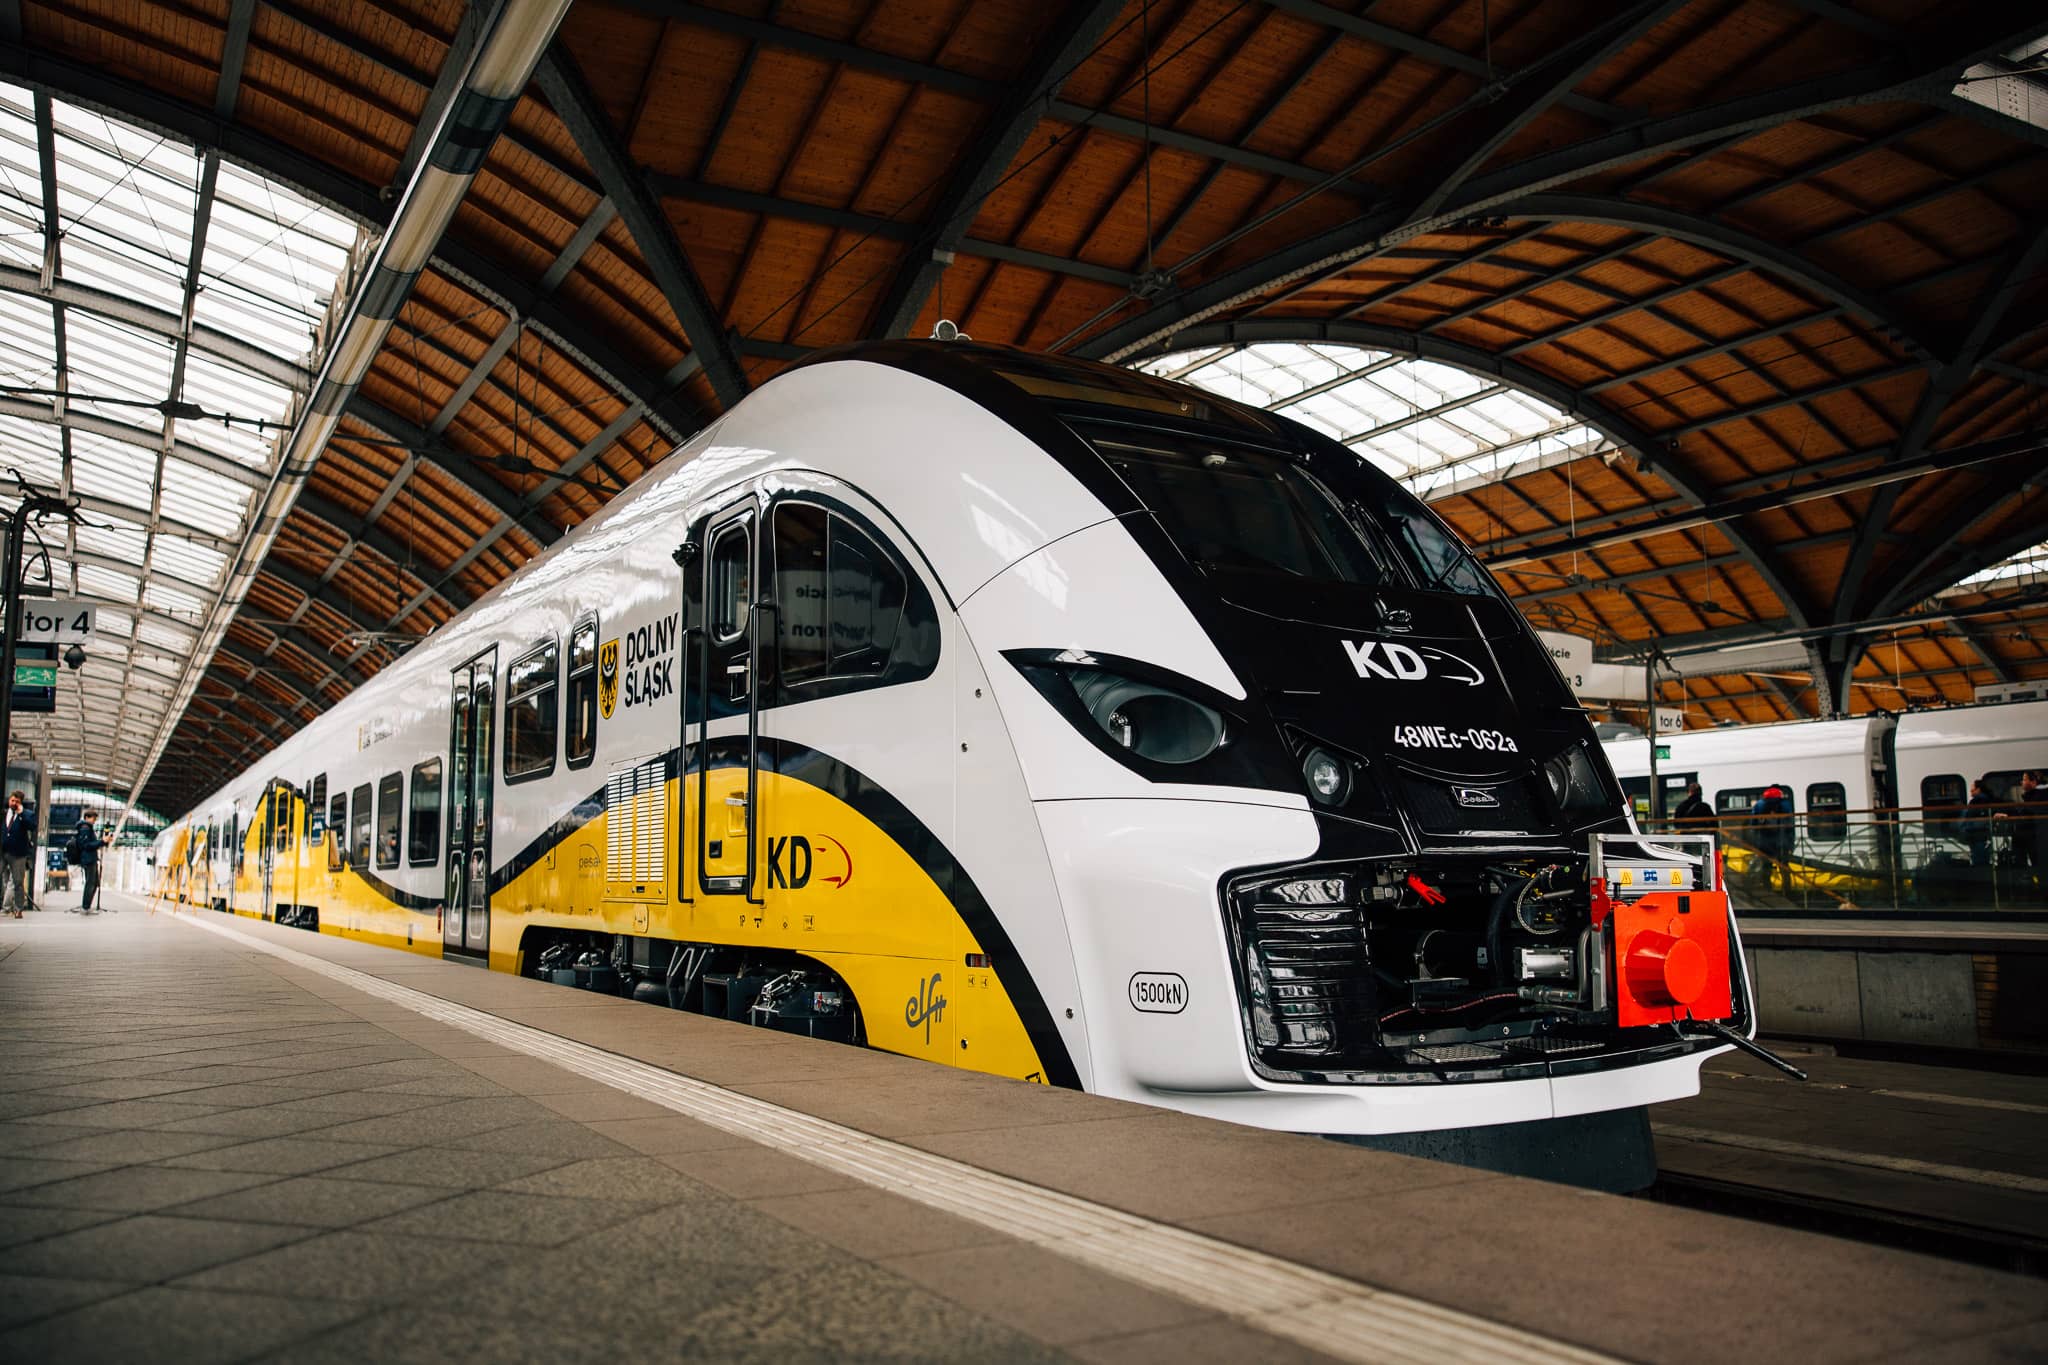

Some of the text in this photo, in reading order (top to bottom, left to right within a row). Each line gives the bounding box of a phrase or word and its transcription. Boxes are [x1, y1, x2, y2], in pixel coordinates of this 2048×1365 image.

[25, 611, 90, 634] tor 4
[626, 612, 678, 667] DOLNY
[1341, 640, 1428, 680] KD
[624, 657, 673, 708] ŚLĄSK
[1575, 675, 1583, 687] 3
[1660, 714, 1682, 728] tor 6
[1394, 725, 1519, 753] 48WEc-062a
[767, 836, 812, 889] KD
[451, 863, 461, 922] 2
[1136, 982, 1181, 1004] 1500kN
